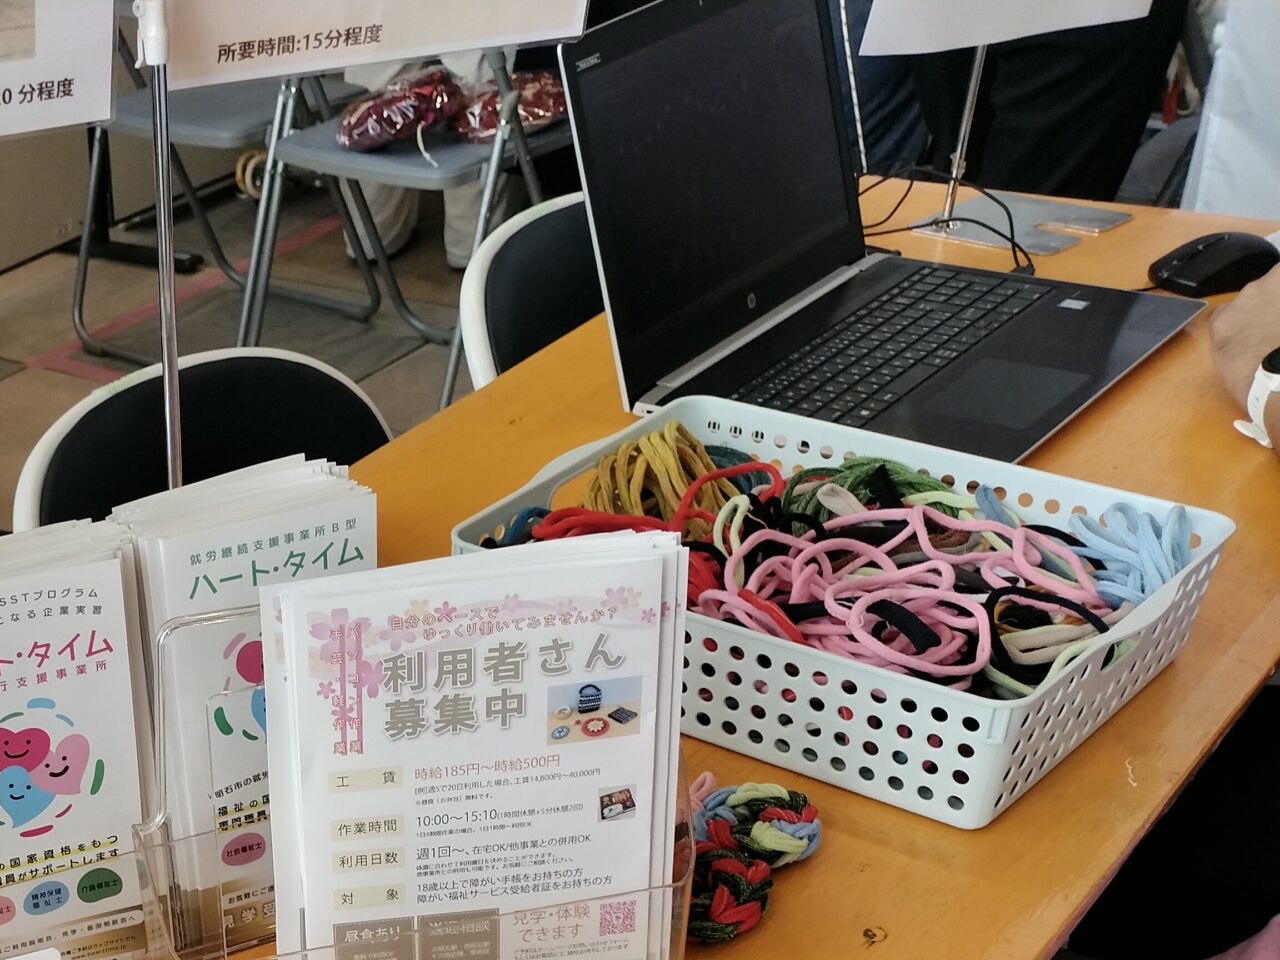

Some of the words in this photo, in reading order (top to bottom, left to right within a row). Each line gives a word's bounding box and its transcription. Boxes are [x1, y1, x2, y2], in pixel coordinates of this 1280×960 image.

[216, 23, 383, 65] 所要時間:15分程度
[17, 78, 76, 106] 分程度
[190, 518, 358, 566] 就労継続支援事業所B型
[189, 538, 365, 600] ハート・タイム
[390, 606, 500, 632] 自分のペースで
[383, 632, 626, 694] 利用者さん
[383, 687, 527, 742] 募集中
[338, 819, 398, 836] 作業時間
[226, 842, 263, 858] 社会福祉士
[339, 851, 398, 868] 利用日数
[340, 888, 399, 905] 対象
[518, 923, 584, 943] できます
